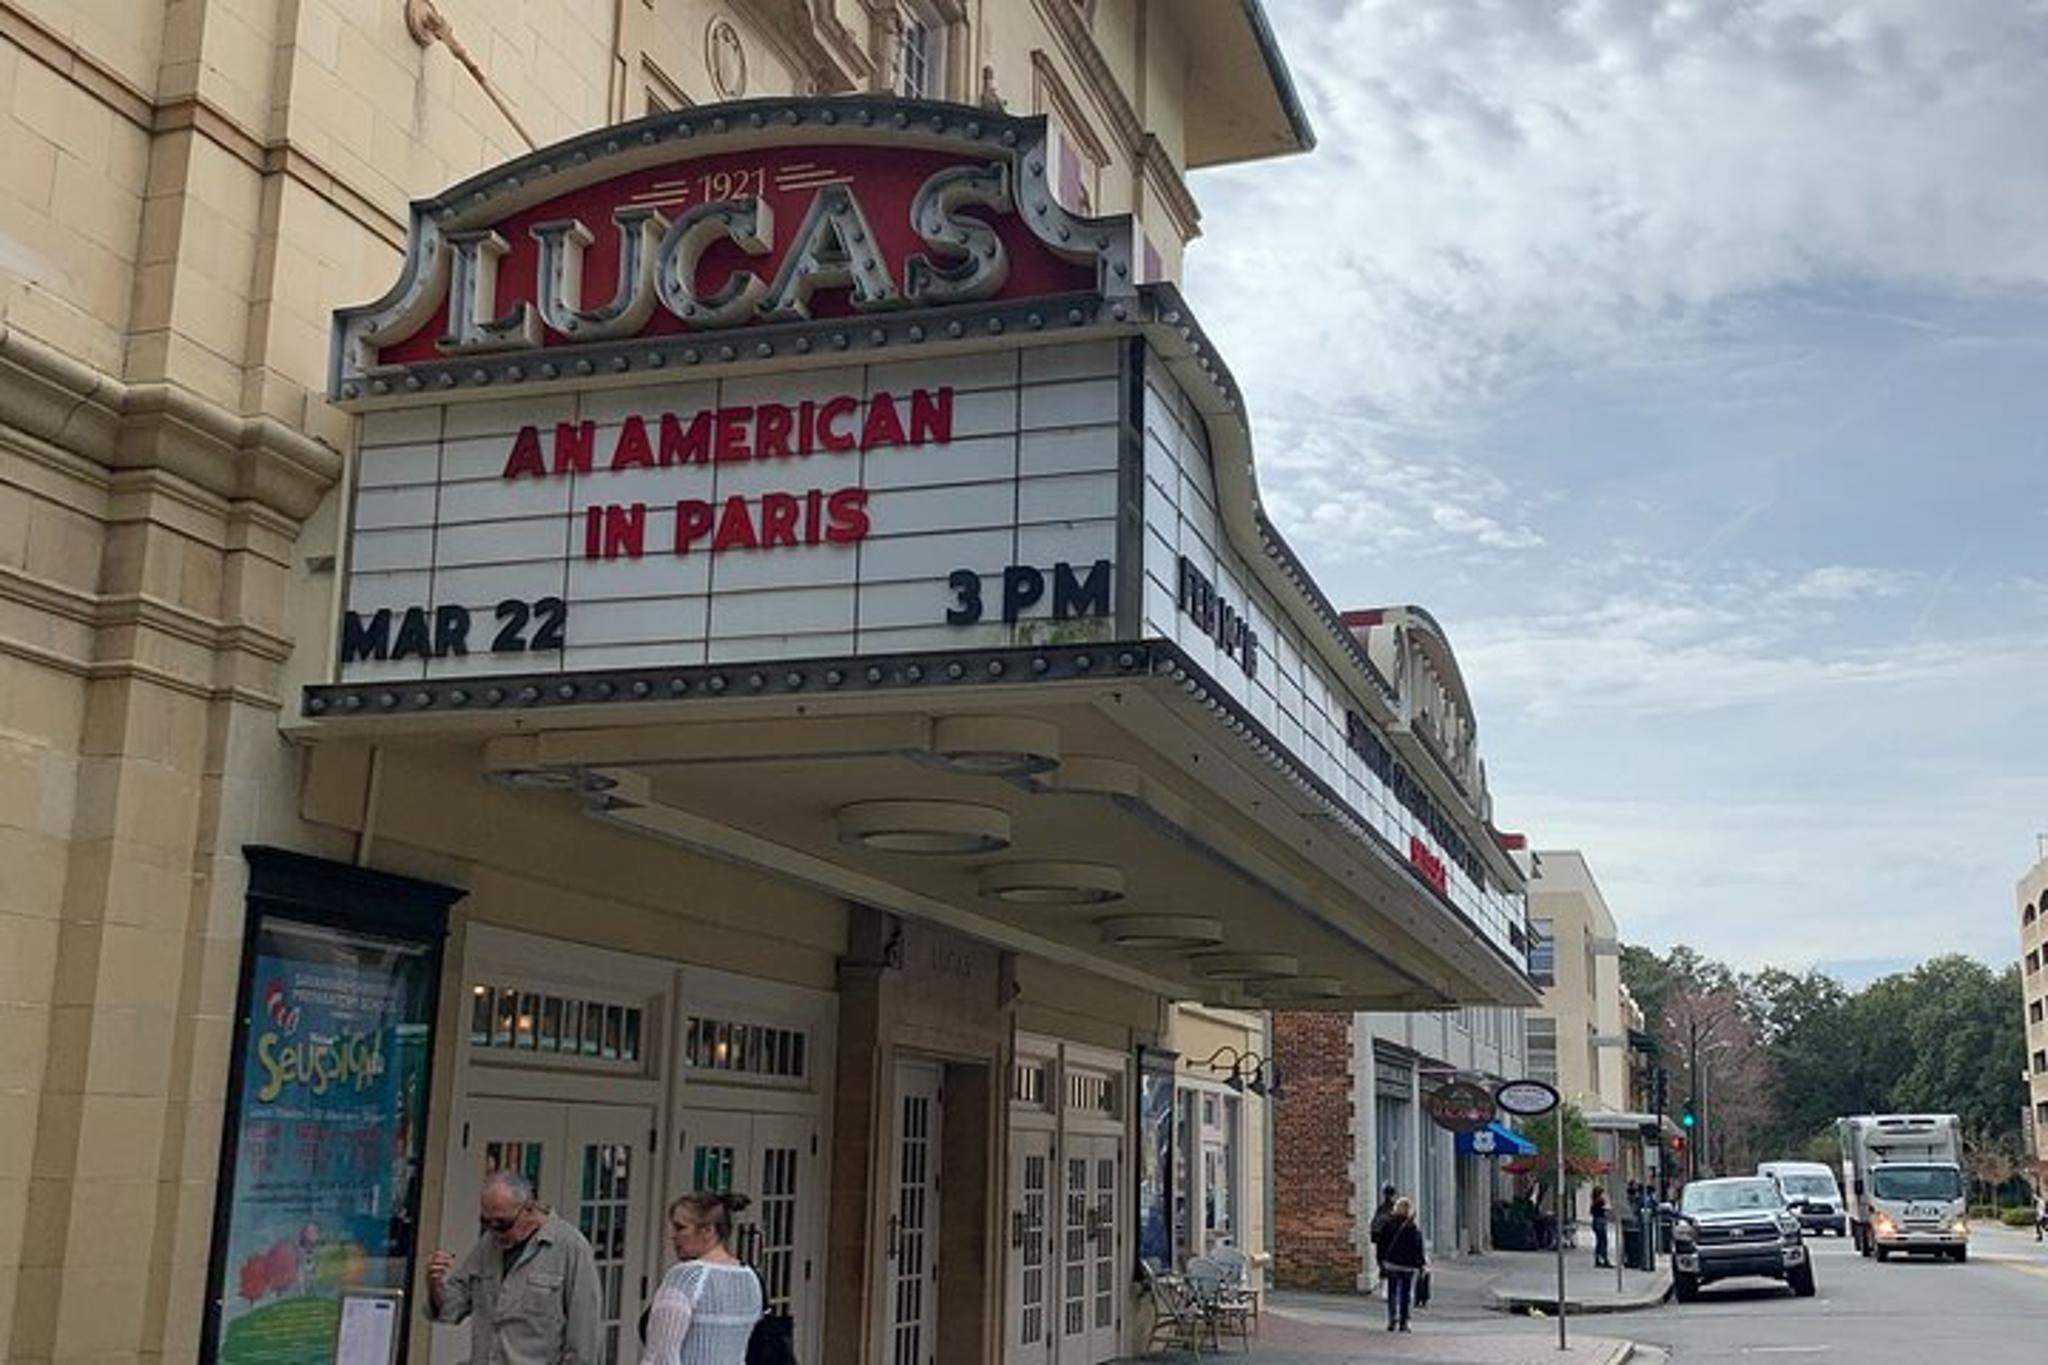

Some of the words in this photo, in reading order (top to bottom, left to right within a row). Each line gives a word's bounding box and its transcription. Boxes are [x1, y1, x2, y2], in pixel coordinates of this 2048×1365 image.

[698, 167, 766, 202] 1921
[436, 164, 1011, 352] LUCAS
[503, 424, 594, 478] AN
[611, 387, 954, 471] AMERICAN
[584, 502, 646, 561] IN
[674, 487, 870, 556] PARIS
[947, 569, 982, 625] 3
[1003, 560, 1110, 623] PM
[341, 605, 471, 663] MAR
[492, 597, 567, 652] 22
